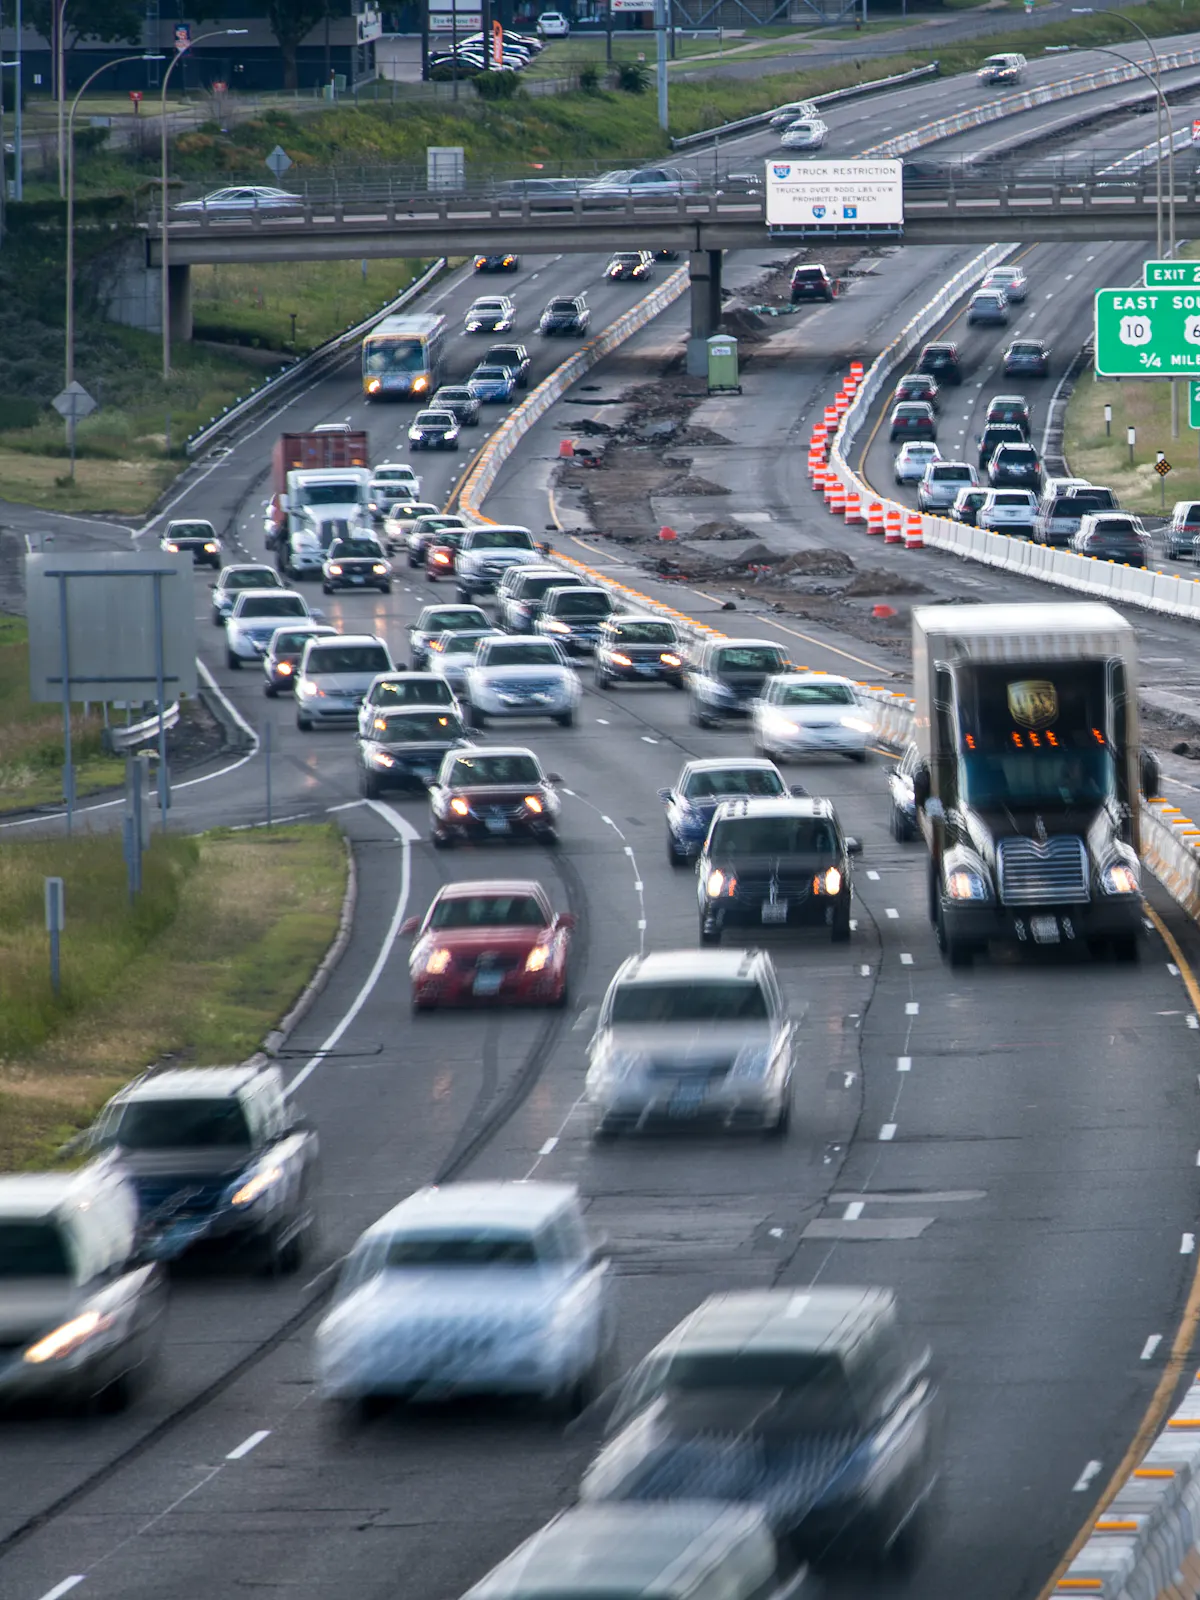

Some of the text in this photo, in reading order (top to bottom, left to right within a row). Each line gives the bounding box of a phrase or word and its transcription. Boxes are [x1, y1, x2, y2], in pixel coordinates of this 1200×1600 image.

[833, 167, 896, 175] RESTRICTION
[814, 208, 825, 216] 94
[847, 209, 853, 217] 5
[1153, 269, 1186, 281] EXIT
[1113, 296, 1158, 310] EAST
[1126, 324, 1144, 339] 10
[1139, 352, 1162, 368] 3/4
